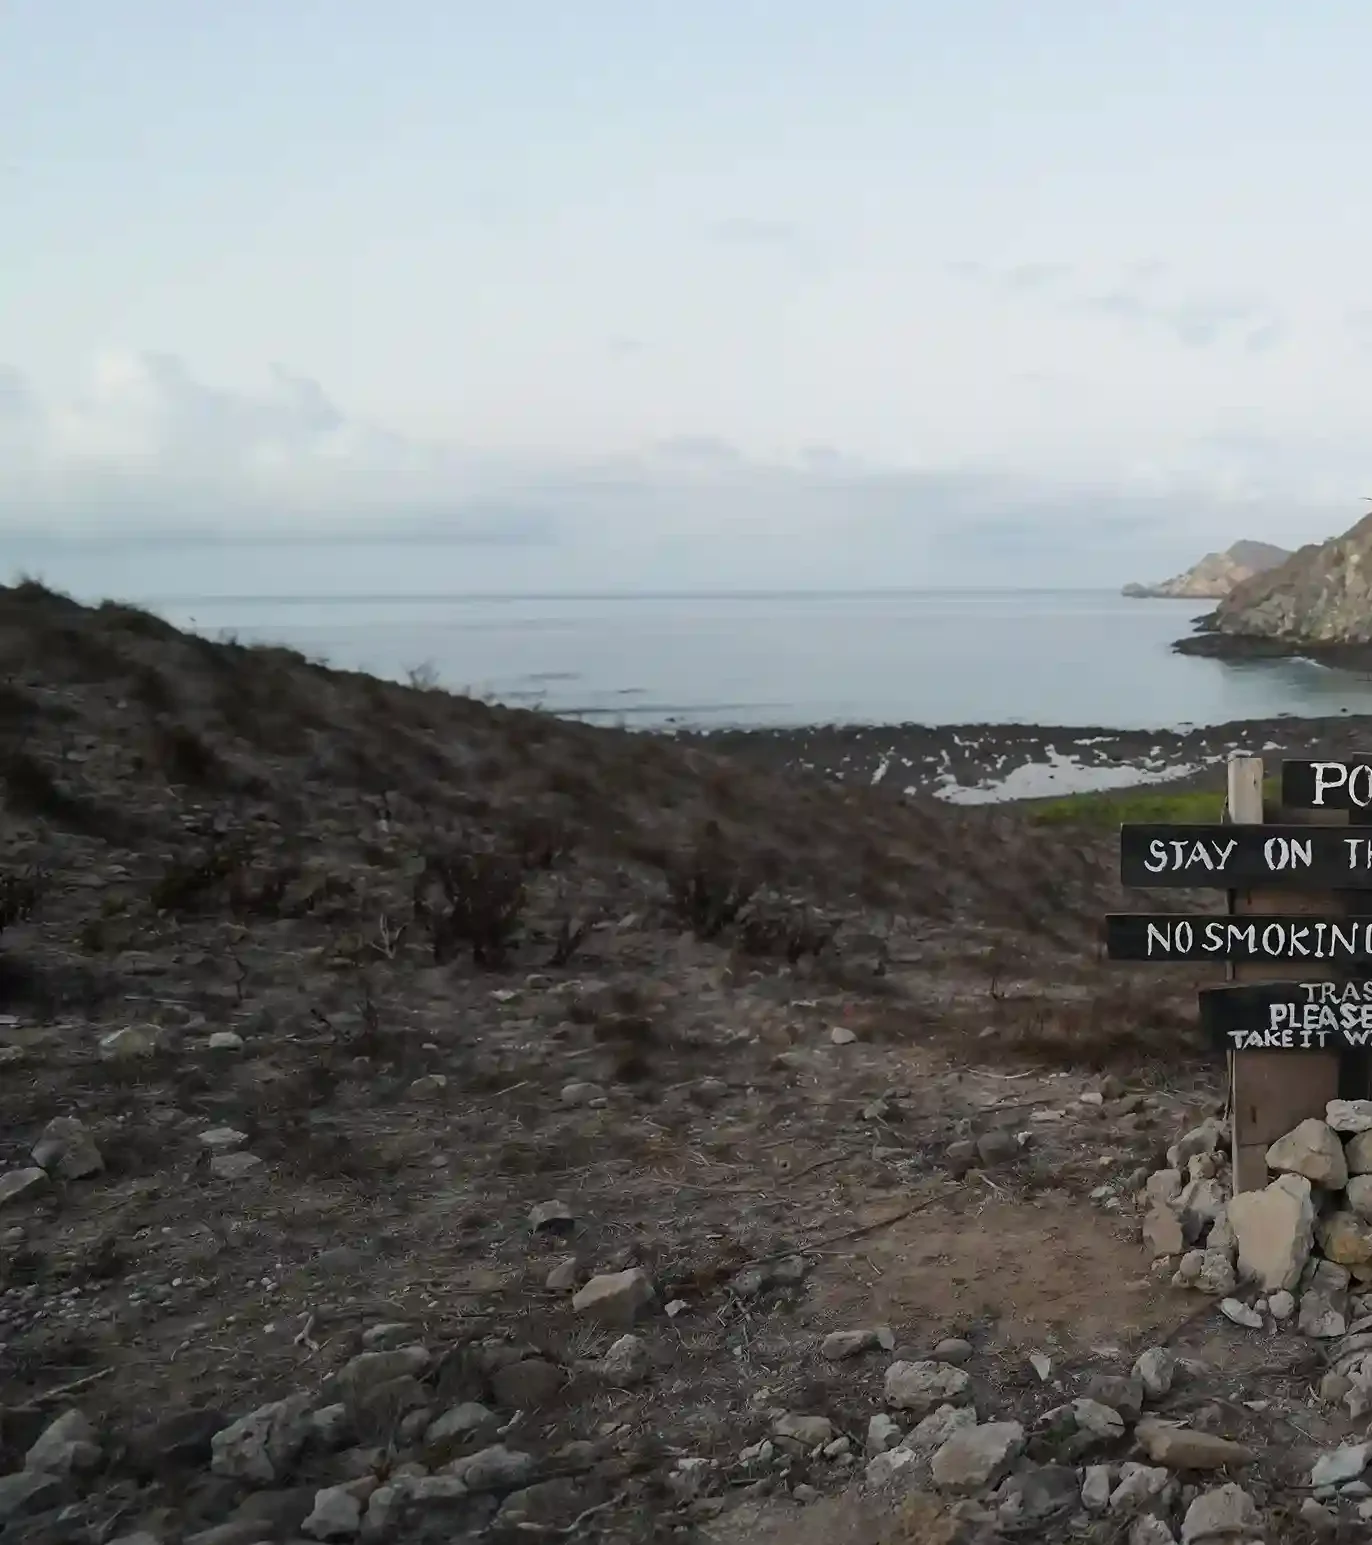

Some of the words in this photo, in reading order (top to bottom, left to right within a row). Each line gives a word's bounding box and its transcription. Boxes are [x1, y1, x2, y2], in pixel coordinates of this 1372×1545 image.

[1143, 839, 1238, 873] STAY
[1264, 837, 1313, 870] ON
[1147, 920, 1193, 956] NO
[1227, 1029, 1294, 1050] TAKE
[1299, 1029, 1333, 1048] IT
